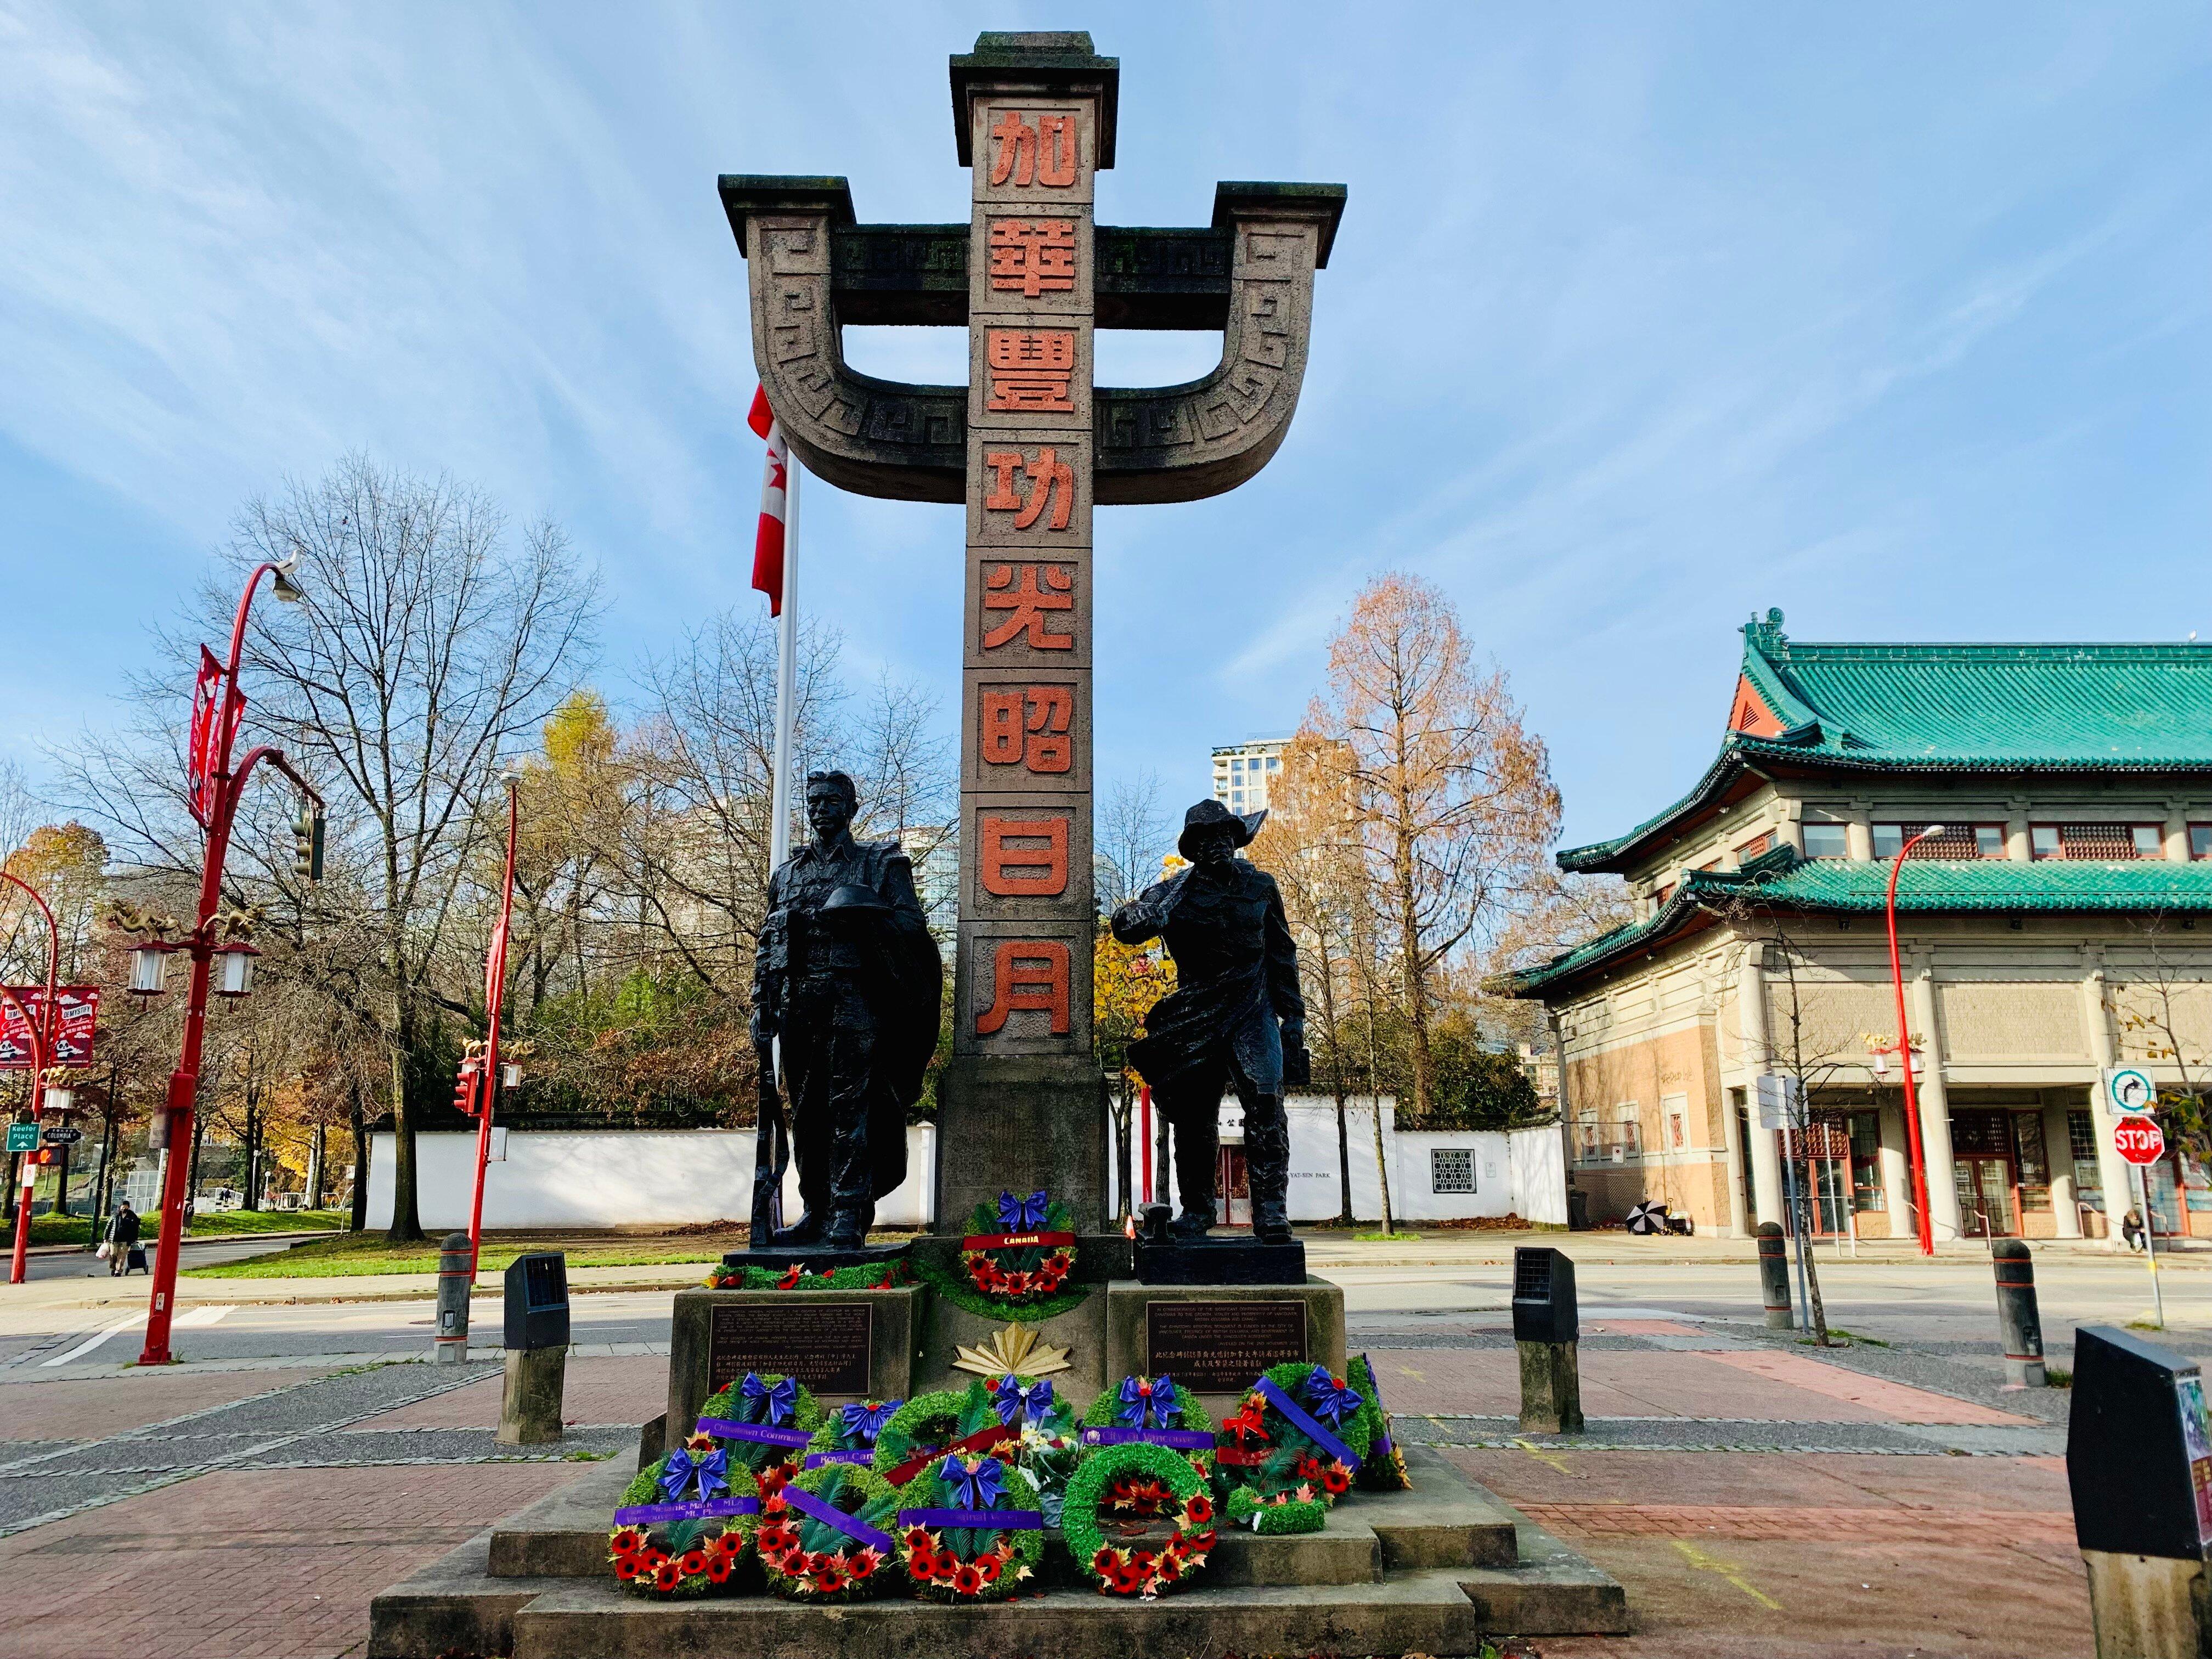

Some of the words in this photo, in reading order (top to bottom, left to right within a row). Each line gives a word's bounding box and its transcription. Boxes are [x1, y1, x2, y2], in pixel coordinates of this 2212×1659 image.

[63, 1006, 91, 1018] DEMYSTIFY
[2115, 1130, 2162, 1150] STOP
[1003, 1235, 1039, 1245] CANADA
[714, 1423, 758, 1436] Chinatown
[1102, 1430, 1121, 1442] City
[1143, 1432, 1200, 1444] Vancouver
[820, 1453, 848, 1464] Royal
[690, 1502, 713, 1510] Mark
